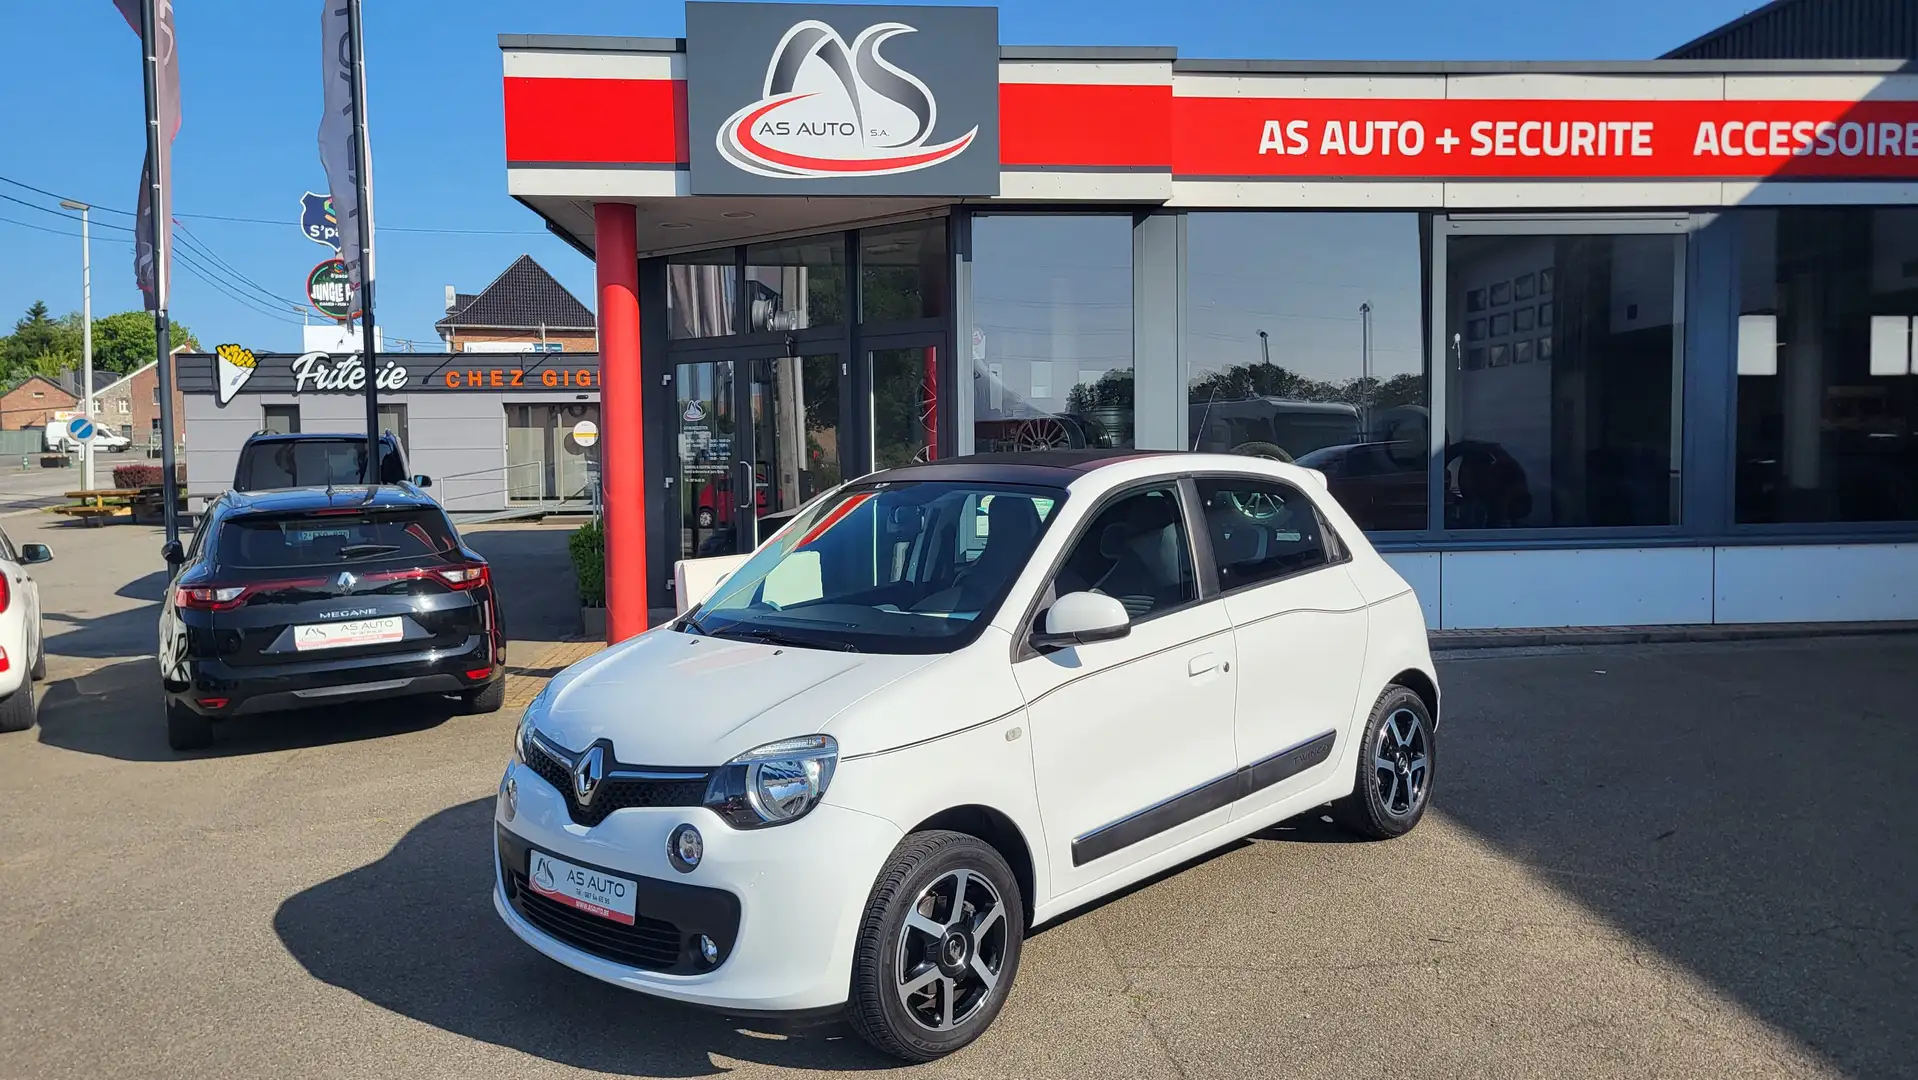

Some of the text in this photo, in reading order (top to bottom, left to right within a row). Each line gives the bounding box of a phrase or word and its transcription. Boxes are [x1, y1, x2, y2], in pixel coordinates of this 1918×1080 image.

[758, 122, 890, 137] AS AUTO S.A.
[1258, 120, 1310, 156] AS
[1320, 120, 1425, 156] AUTO
[1469, 120, 1654, 157] SECURITE
[311, 282, 344, 302] JUNGLE
[292, 352, 409, 392] Friteie
[446, 370, 524, 387] CHEZ
[320, 608, 377, 619] MEGANE
[341, 620, 393, 631] AS AUTO
[1293, 745, 1328, 764] TWINGO
[566, 869, 585, 886] AS
[587, 876, 625, 898] AUTO
